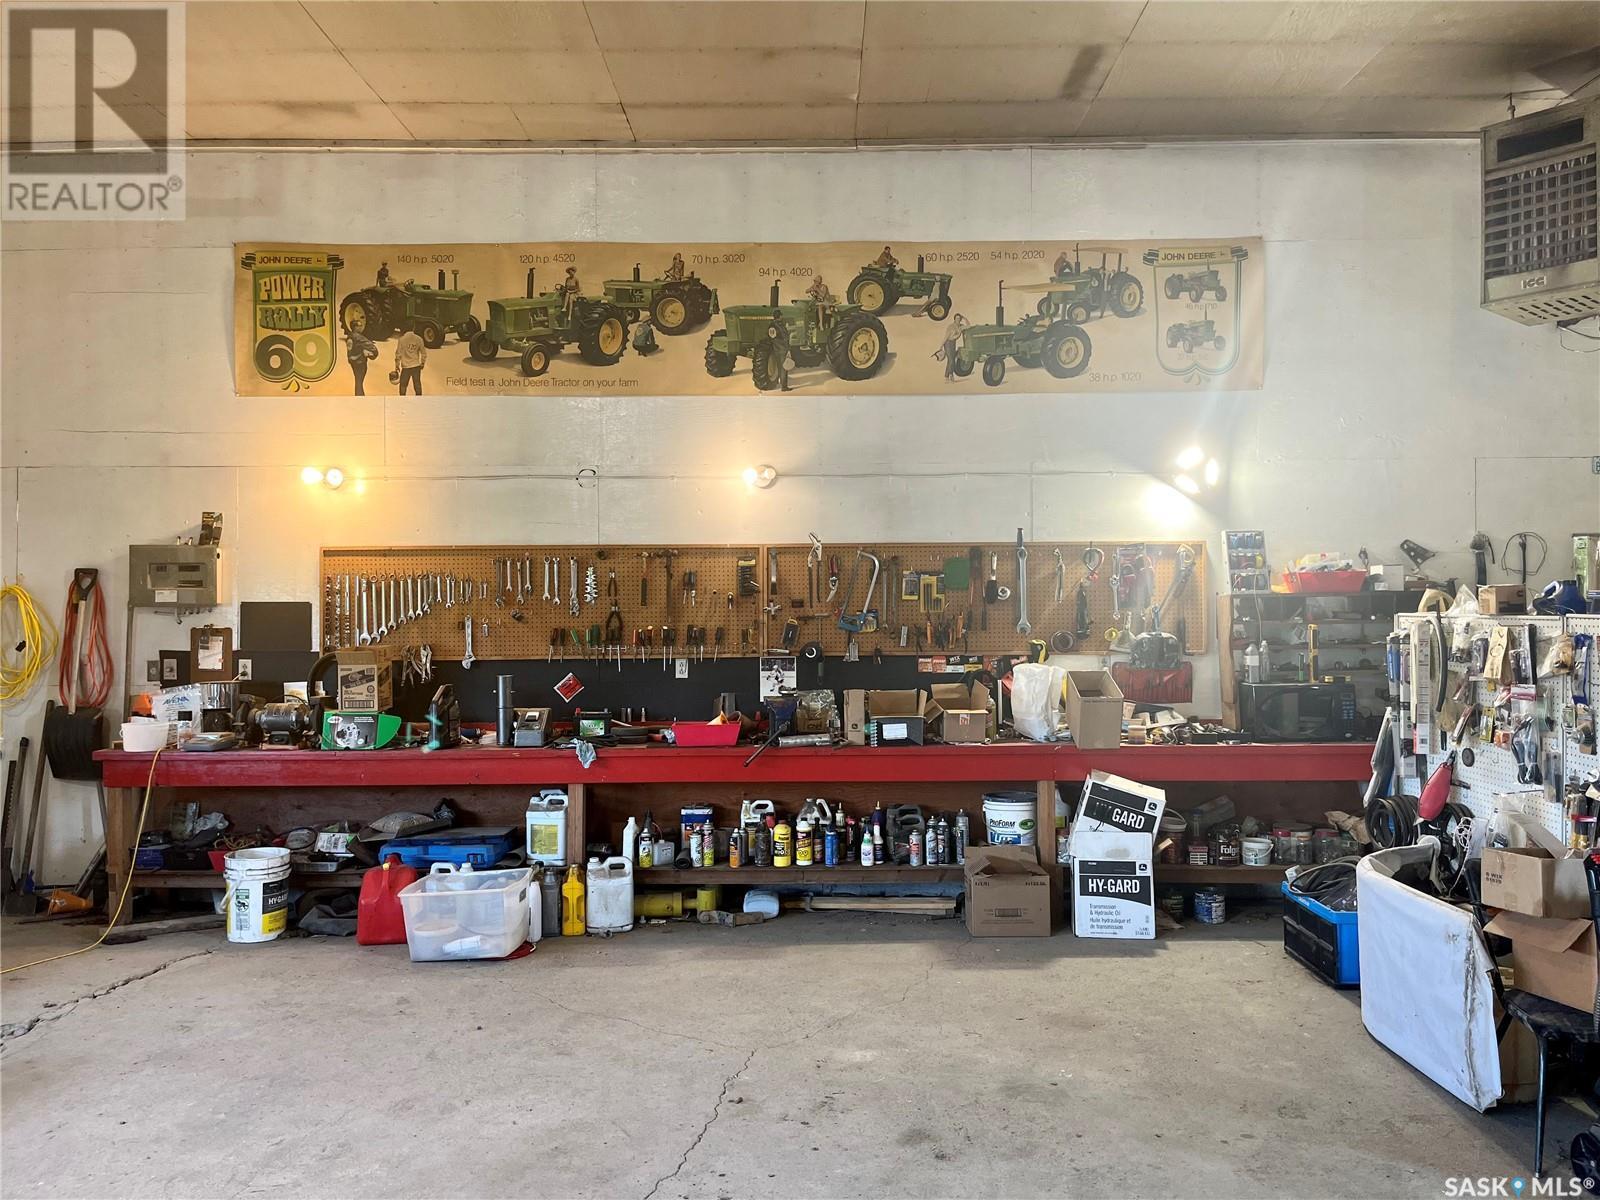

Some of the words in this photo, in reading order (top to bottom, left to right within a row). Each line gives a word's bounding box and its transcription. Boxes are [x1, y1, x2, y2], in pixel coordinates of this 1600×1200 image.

[258, 256, 281, 264] JOHN
[283, 256, 313, 264] DEERE
[397, 255, 412, 264] 140
[431, 254, 455, 264] 5020
[519, 255, 534, 264] 120
[552, 253, 576, 263] 4520
[692, 254, 703, 264] 70
[722, 253, 745, 263] 3020
[925, 252, 937, 262] 60
[956, 251, 980, 261] 2520
[990, 251, 1002, 260] 54
[1021, 250, 1045, 260] 2020
[1161, 252, 1185, 261] JOHN
[1187, 251, 1217, 260] DEERE
[758, 267, 770, 277] 94
[790, 267, 813, 277] 4020
[258, 274, 326, 302] POWER
[259, 305, 327, 332] RALLY
[255, 333, 331, 379] 69
[446, 376, 467, 386] Field
[469, 378, 486, 387] test
[498, 377, 521, 387] John
[522, 378, 550, 387] Deere
[551, 377, 580, 387] Tractor
[597, 380, 616, 388] your
[618, 377, 639, 387] farm
[1088, 372, 1102, 383] 38
[1120, 371, 1143, 381] 1020
[1088, 878, 1140, 894] HY-GARD
